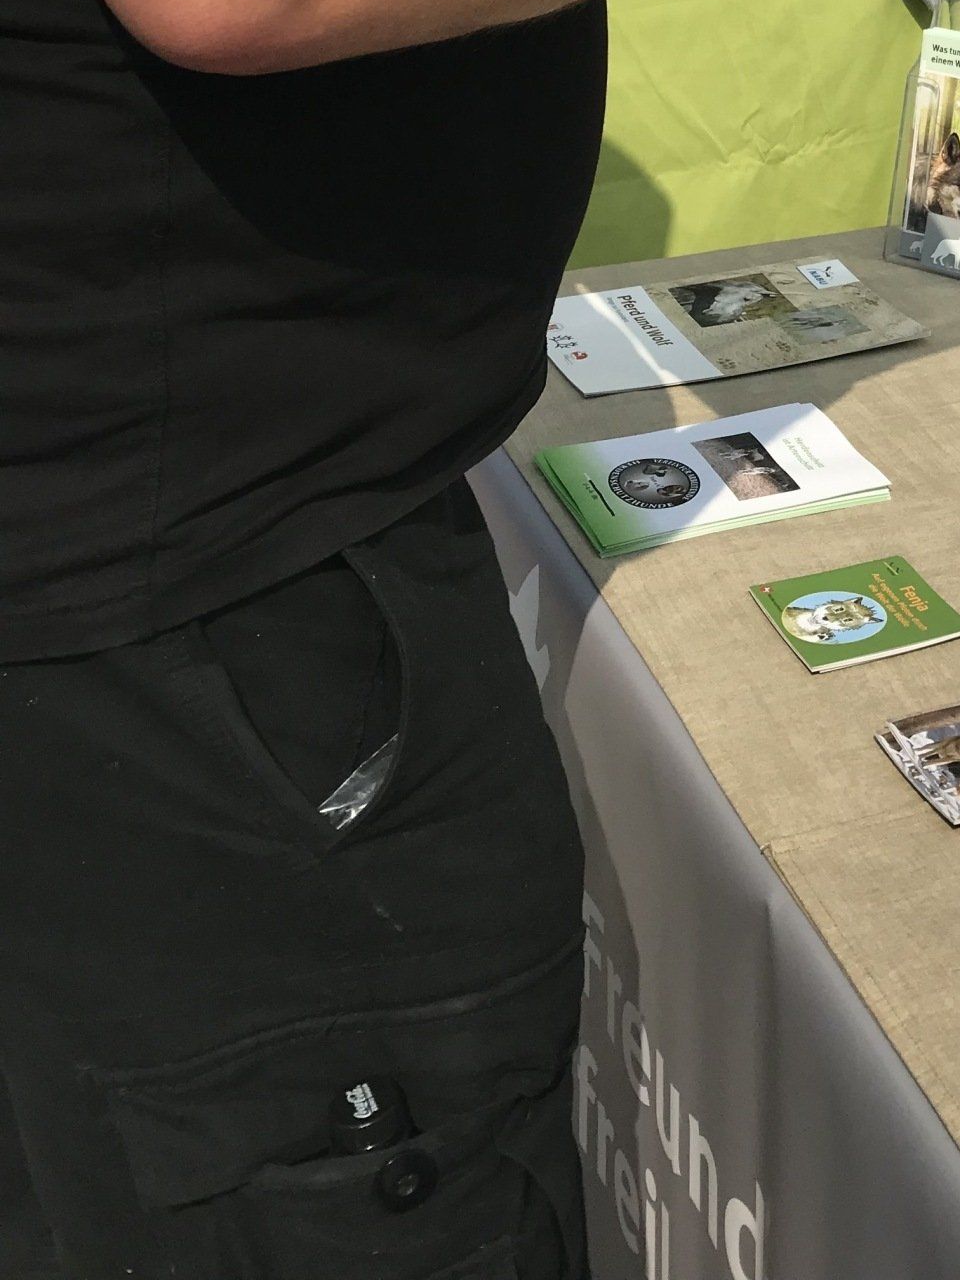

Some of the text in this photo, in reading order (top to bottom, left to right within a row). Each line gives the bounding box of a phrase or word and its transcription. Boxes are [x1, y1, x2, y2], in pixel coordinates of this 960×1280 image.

[932, 44, 948, 55] Was
[931, 57, 953, 66] einem
[617, 294, 645, 317] Pferd
[900, 585, 928, 613] Fenja
